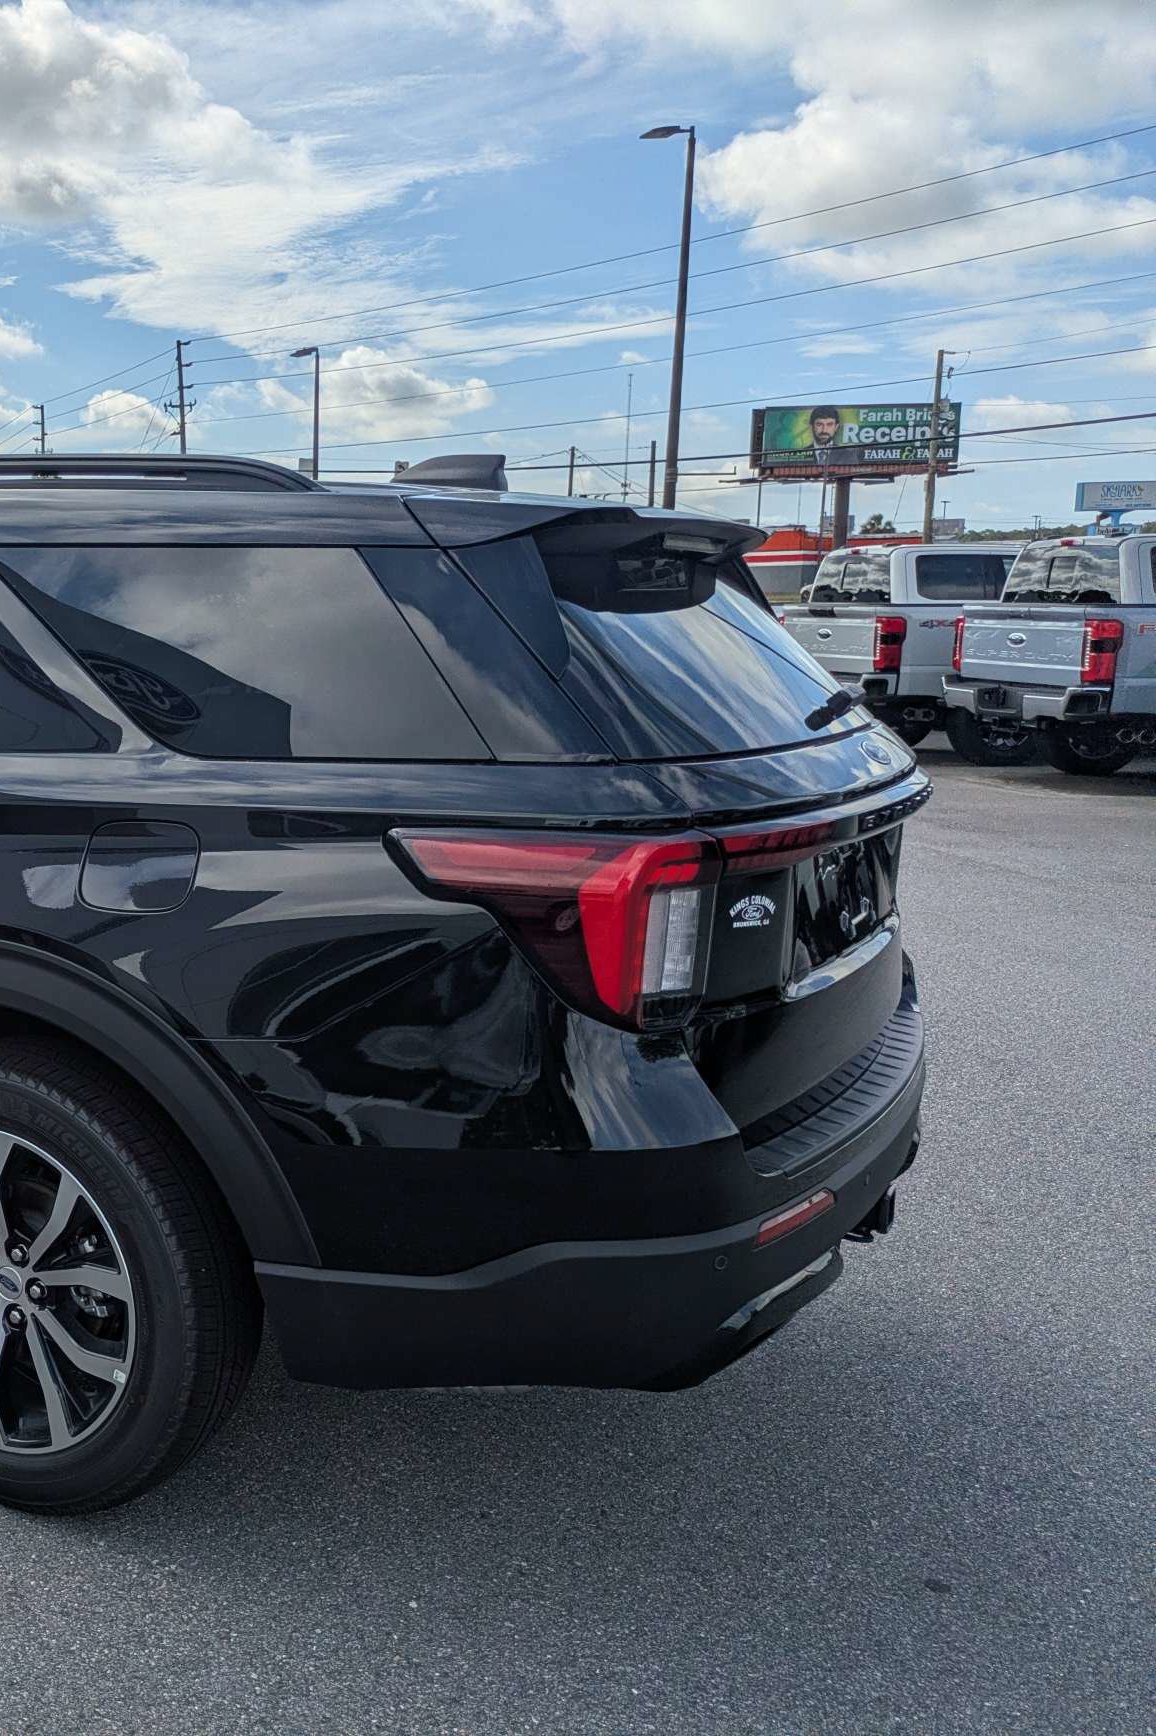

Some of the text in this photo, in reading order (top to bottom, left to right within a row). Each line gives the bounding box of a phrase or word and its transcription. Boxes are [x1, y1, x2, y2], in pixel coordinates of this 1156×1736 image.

[859, 408, 955, 423] Farah Bris
[844, 421, 955, 446] Receips
[864, 448, 901, 459] FARAH
[917, 448, 954, 458] FAAH
[729, 895, 776, 917] KINGS COLONIAL
